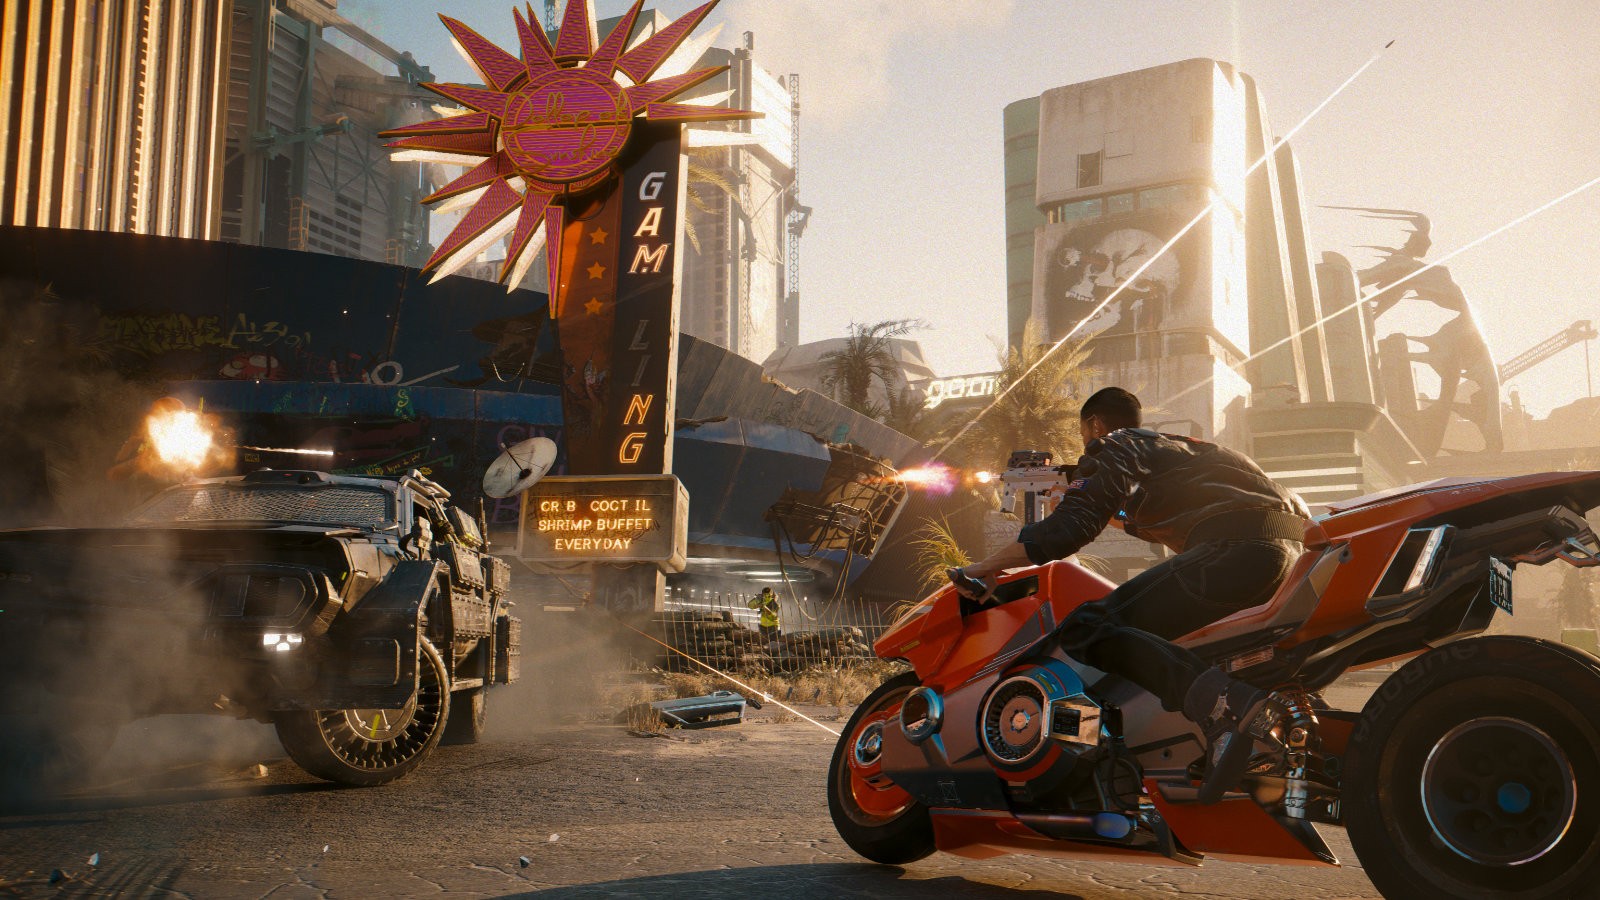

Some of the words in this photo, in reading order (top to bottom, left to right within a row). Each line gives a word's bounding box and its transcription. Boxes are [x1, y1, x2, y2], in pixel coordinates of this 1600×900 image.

[538, 518, 592, 531] SHRIMP
[596, 517, 653, 531] BUFFET
[554, 537, 632, 550] EVERYDAY
